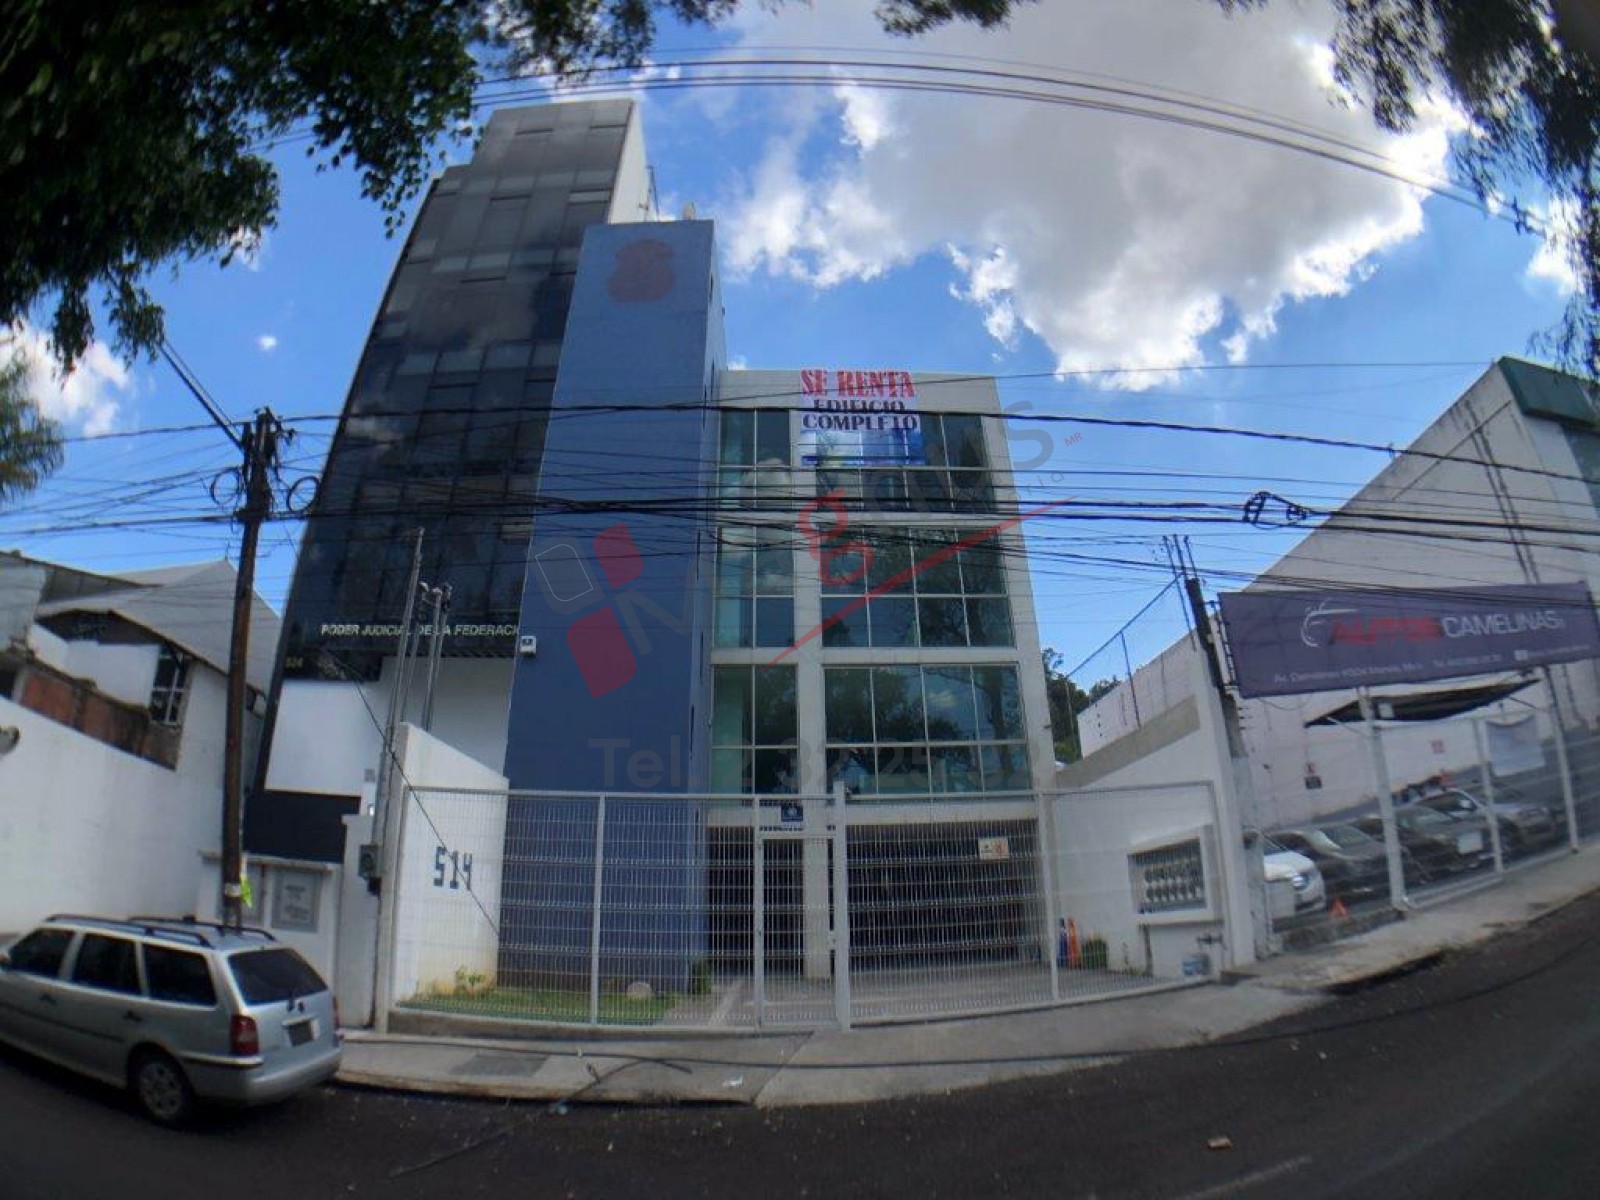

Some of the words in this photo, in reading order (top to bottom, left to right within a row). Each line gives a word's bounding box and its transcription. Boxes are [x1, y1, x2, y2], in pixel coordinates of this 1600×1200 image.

[801, 369, 828, 397] SE
[836, 369, 915, 398] RENTA
[813, 399, 906, 413] EDIFICIO
[802, 413, 918, 431] COMPLETO
[320, 624, 360, 637] PODER
[1440, 609, 1559, 639] CAMELINAS
[432, 845, 473, 891] 514
